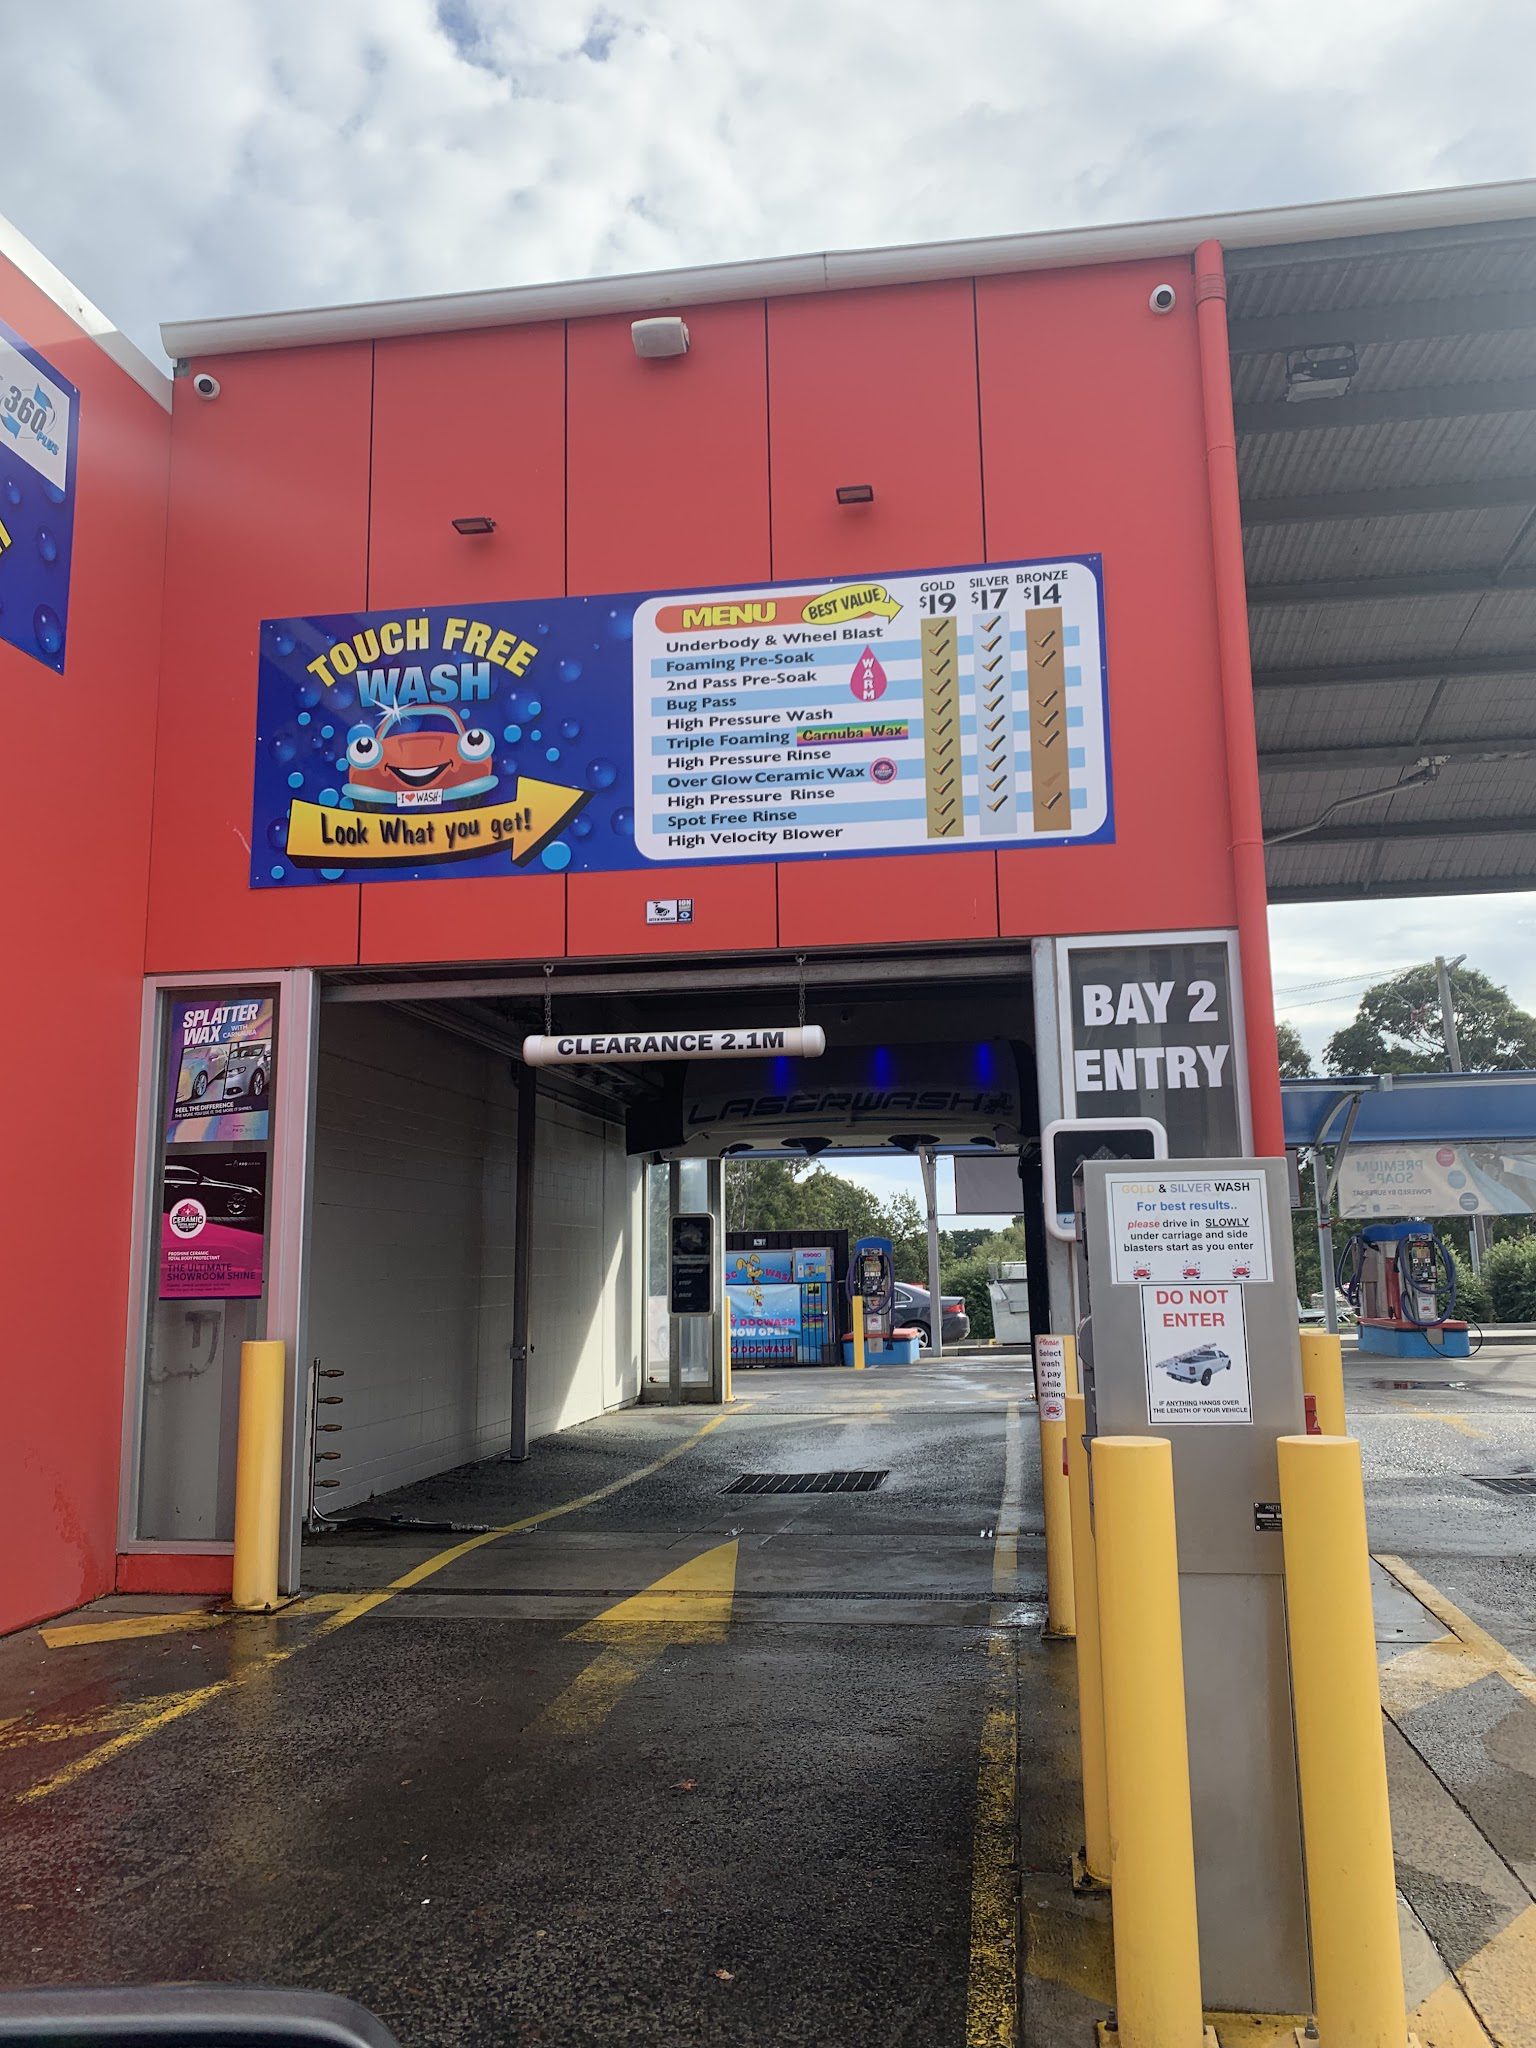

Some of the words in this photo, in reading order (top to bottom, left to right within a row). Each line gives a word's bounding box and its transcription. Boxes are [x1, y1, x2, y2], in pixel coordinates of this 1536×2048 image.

[4, 386, 46, 434] 360
[36, 431, 59, 456] PLUS
[920, 580, 955, 592] GOLD
[970, 576, 1009, 588] SILVER
[1016, 570, 1068, 584] BRONZE
[808, 600, 838, 620] BEST
[841, 588, 880, 610] VALUE
[920, 592, 956, 614] $19
[971, 588, 1008, 610] $17
[1024, 583, 1062, 606] $14
[682, 602, 776, 628] MENU
[666, 636, 760, 652] Underbody
[766, 635, 777, 645] &
[783, 630, 836, 644] Wheel
[843, 627, 883, 640] Blast
[306, 618, 429, 687] TOUCH
[442, 618, 538, 677] FREE
[666, 658, 735, 672] Foaming
[740, 652, 814, 668] Pre-Soak
[356, 662, 490, 708] WASH
[666, 679, 698, 692] 2nd
[703, 677, 736, 689] Pass
[743, 671, 816, 686] Pre-Soak
[862, 658, 874, 700] WARM
[667, 699, 698, 712] Bug
[703, 697, 736, 708] Pass
[667, 717, 704, 732] High
[710, 714, 780, 728] Pressure
[786, 709, 832, 722] Wash
[667, 736, 714, 750] Triple
[720, 731, 790, 746] Foaming
[802, 727, 864, 741] Carnuba
[871, 725, 902, 736] Wax
[668, 756, 704, 770] High
[710, 752, 781, 766] Pressure
[788, 750, 831, 762] Rinse
[668, 776, 707, 788] Over
[712, 774, 752, 786] Glow
[756, 770, 824, 784] Ceramic
[828, 766, 864, 778] Wax
[416, 792, 438, 802] WASH
[668, 795, 704, 810] High
[710, 792, 782, 804] Pressure
[791, 788, 835, 800] Rinse
[321, 812, 368, 845] Look
[380, 817, 434, 844] What
[445, 819, 480, 849] you
[491, 808, 532, 841] get!
[668, 815, 706, 829] Spot
[712, 812, 747, 824] Free
[753, 809, 797, 822] Rinse
[668, 834, 705, 848] High
[711, 830, 778, 844] Velocity
[783, 828, 843, 840] Blower
[1083, 981, 1175, 1026] BAY
[1188, 980, 1218, 1022] 2
[182, 1004, 259, 1028] SPLATTER
[184, 1025, 222, 1045] WAX
[558, 1034, 714, 1056] CLEARANCE
[720, 1031, 785, 1050] 2.1M
[1074, 1044, 1230, 1092] ENTRY
[200, 1102, 234, 1110] DIFFERENCE
[688, 1092, 984, 1125] LASERWASH
[1122, 1184, 1154, 1194] GOLD
[1158, 1184, 1166, 1193] &
[1170, 1183, 1211, 1193] SILVER
[1214, 1182, 1250, 1192] WASH
[1137, 1202, 1156, 1212] For
[1160, 1201, 1185, 1211] best
[1190, 1200, 1237, 1210] results..
[172, 1216, 203, 1224] CERAMIC
[1128, 1219, 1160, 1230] please
[1162, 1219, 1187, 1228] drive
[1190, 1219, 1199, 1227] in
[1206, 1218, 1250, 1228] SLOWLY
[1130, 1232, 1158, 1240] under
[1162, 1230, 1202, 1241] carriage
[1206, 1230, 1224, 1239] and
[1227, 1230, 1248, 1238] side
[1124, 1243, 1163, 1252] blasters
[1166, 1242, 1190, 1251] start
[1206, 1244, 1224, 1252] you
[1228, 1242, 1254, 1251] enter
[168, 1272, 224, 1280] SHOWROOM
[227, 1271, 256, 1280] SHINE
[188, 1263, 232, 1272] ULTIMATE
[1156, 1290, 1184, 1304] DO
[1190, 1290, 1228, 1304] NOT
[740, 1318, 795, 1326] DOGWASH
[1163, 1313, 1225, 1327] ENTER
[730, 1328, 756, 1337] NOW
[759, 1327, 789, 1336] OPEN
[1040, 1391, 1065, 1399] waiting
